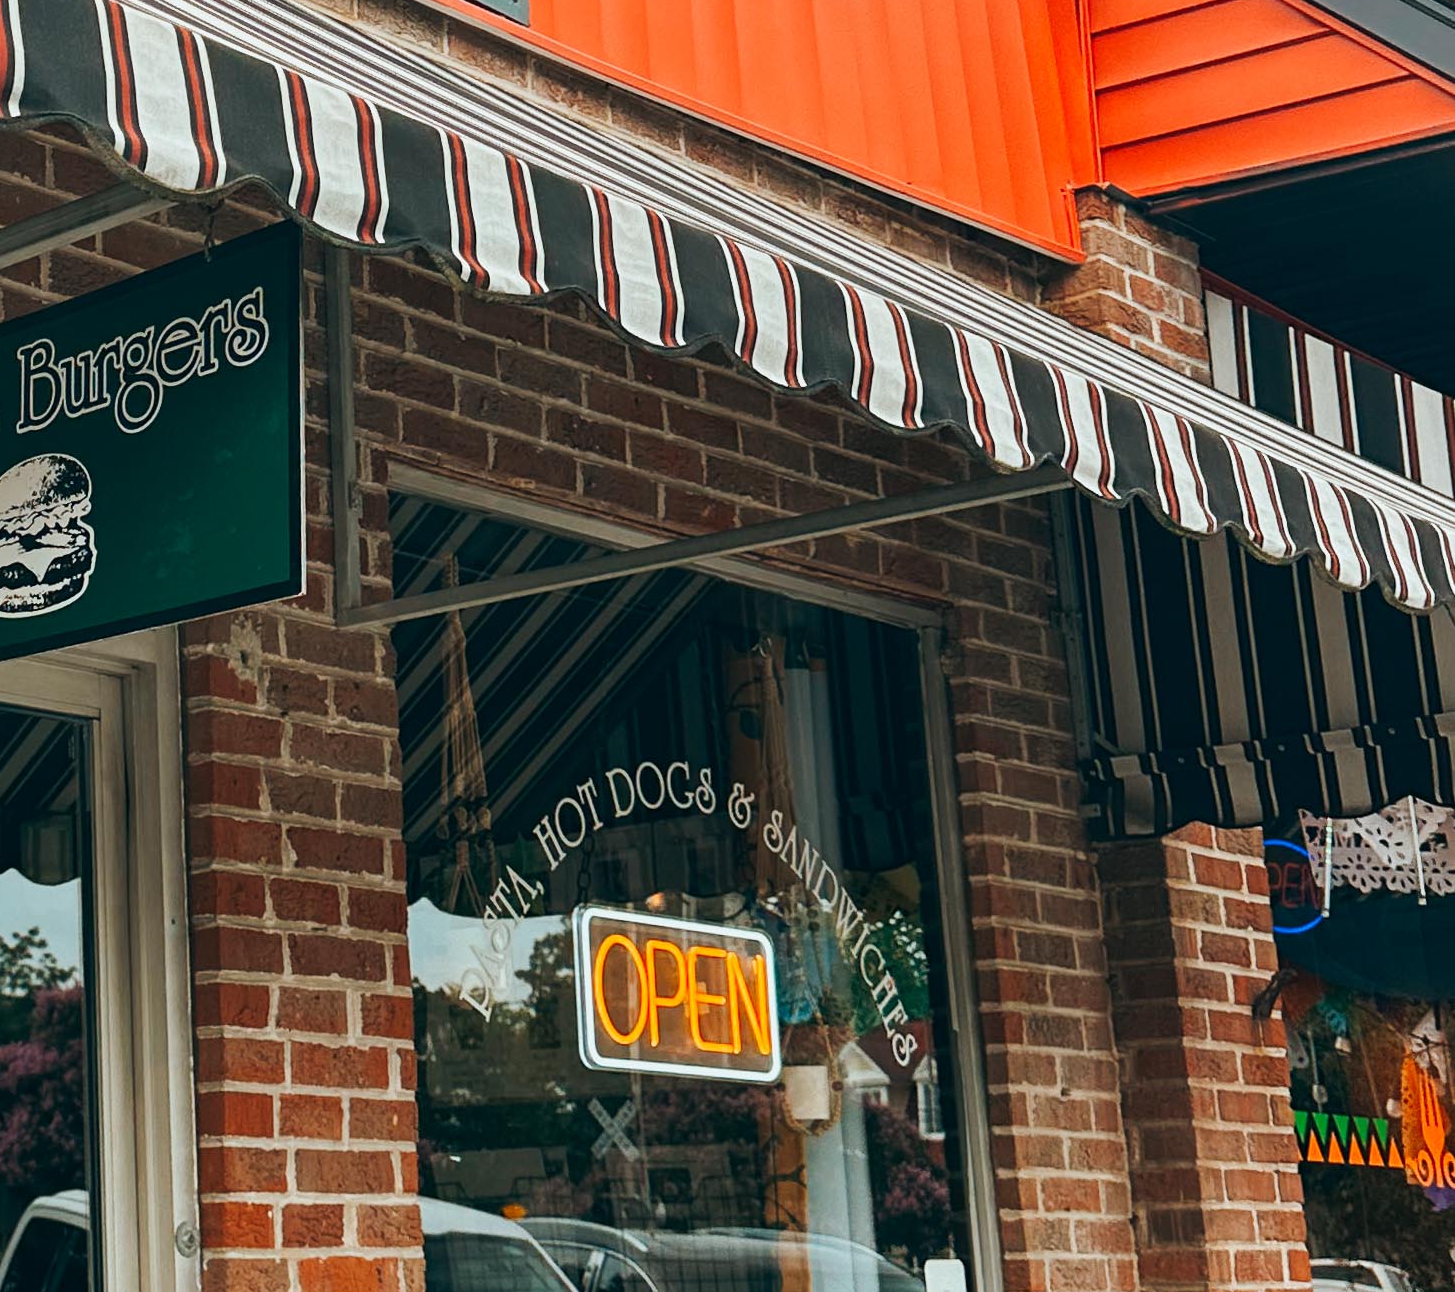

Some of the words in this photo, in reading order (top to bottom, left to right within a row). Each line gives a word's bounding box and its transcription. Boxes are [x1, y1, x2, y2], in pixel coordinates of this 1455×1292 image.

[16, 287, 269, 433] Burgers
[459, 865, 544, 1022] PASTA,
[533, 778, 603, 870] HOT
[605, 762, 716, 818] DOGS
[728, 783, 755, 829] &
[763, 811, 917, 1067] SANDWICHES
[1266, 862, 1321, 910] PEN
[594, 934, 771, 1056] OPEN
